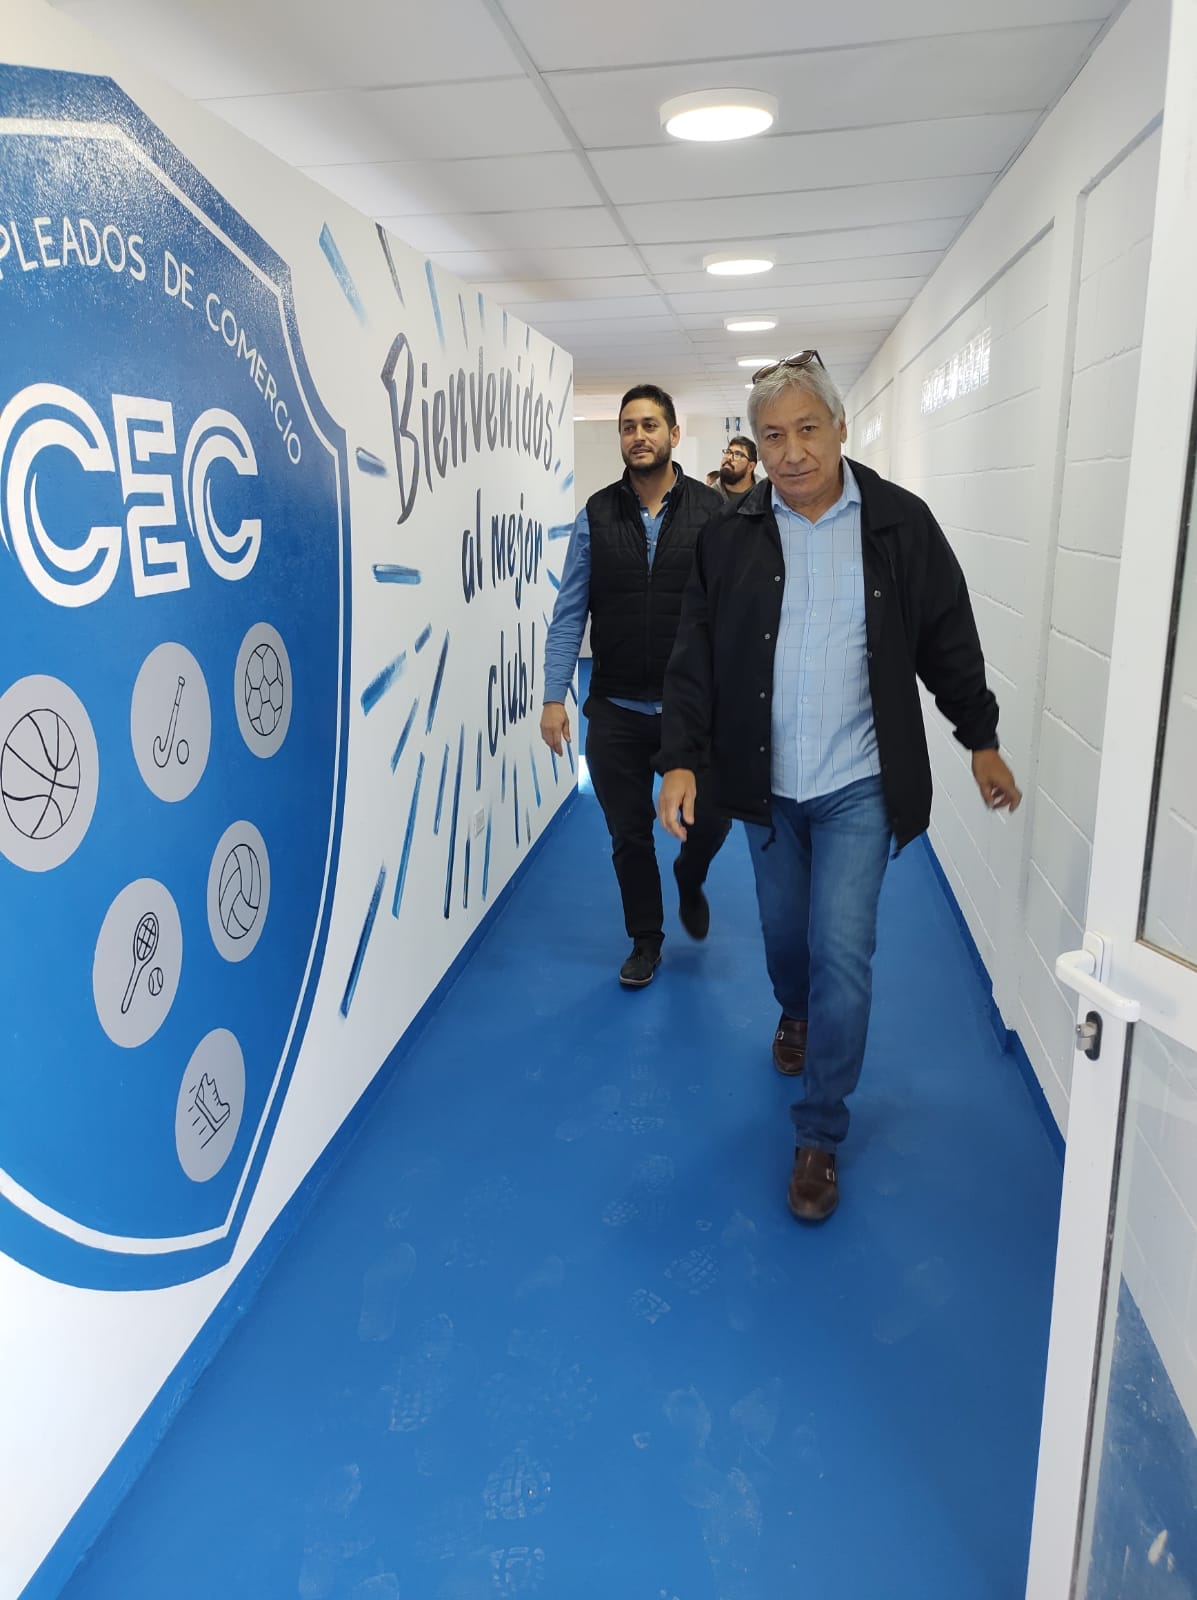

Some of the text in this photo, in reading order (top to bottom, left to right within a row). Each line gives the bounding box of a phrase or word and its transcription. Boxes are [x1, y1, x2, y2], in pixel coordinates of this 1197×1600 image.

[163, 250, 195, 310] DE
[205, 292, 302, 465] COMERCIO
[380, 332, 554, 525] Bienvenidos
[0, 382, 262, 608] CEC
[461, 487, 543, 610] al mejor
[487, 621, 536, 758] club!
